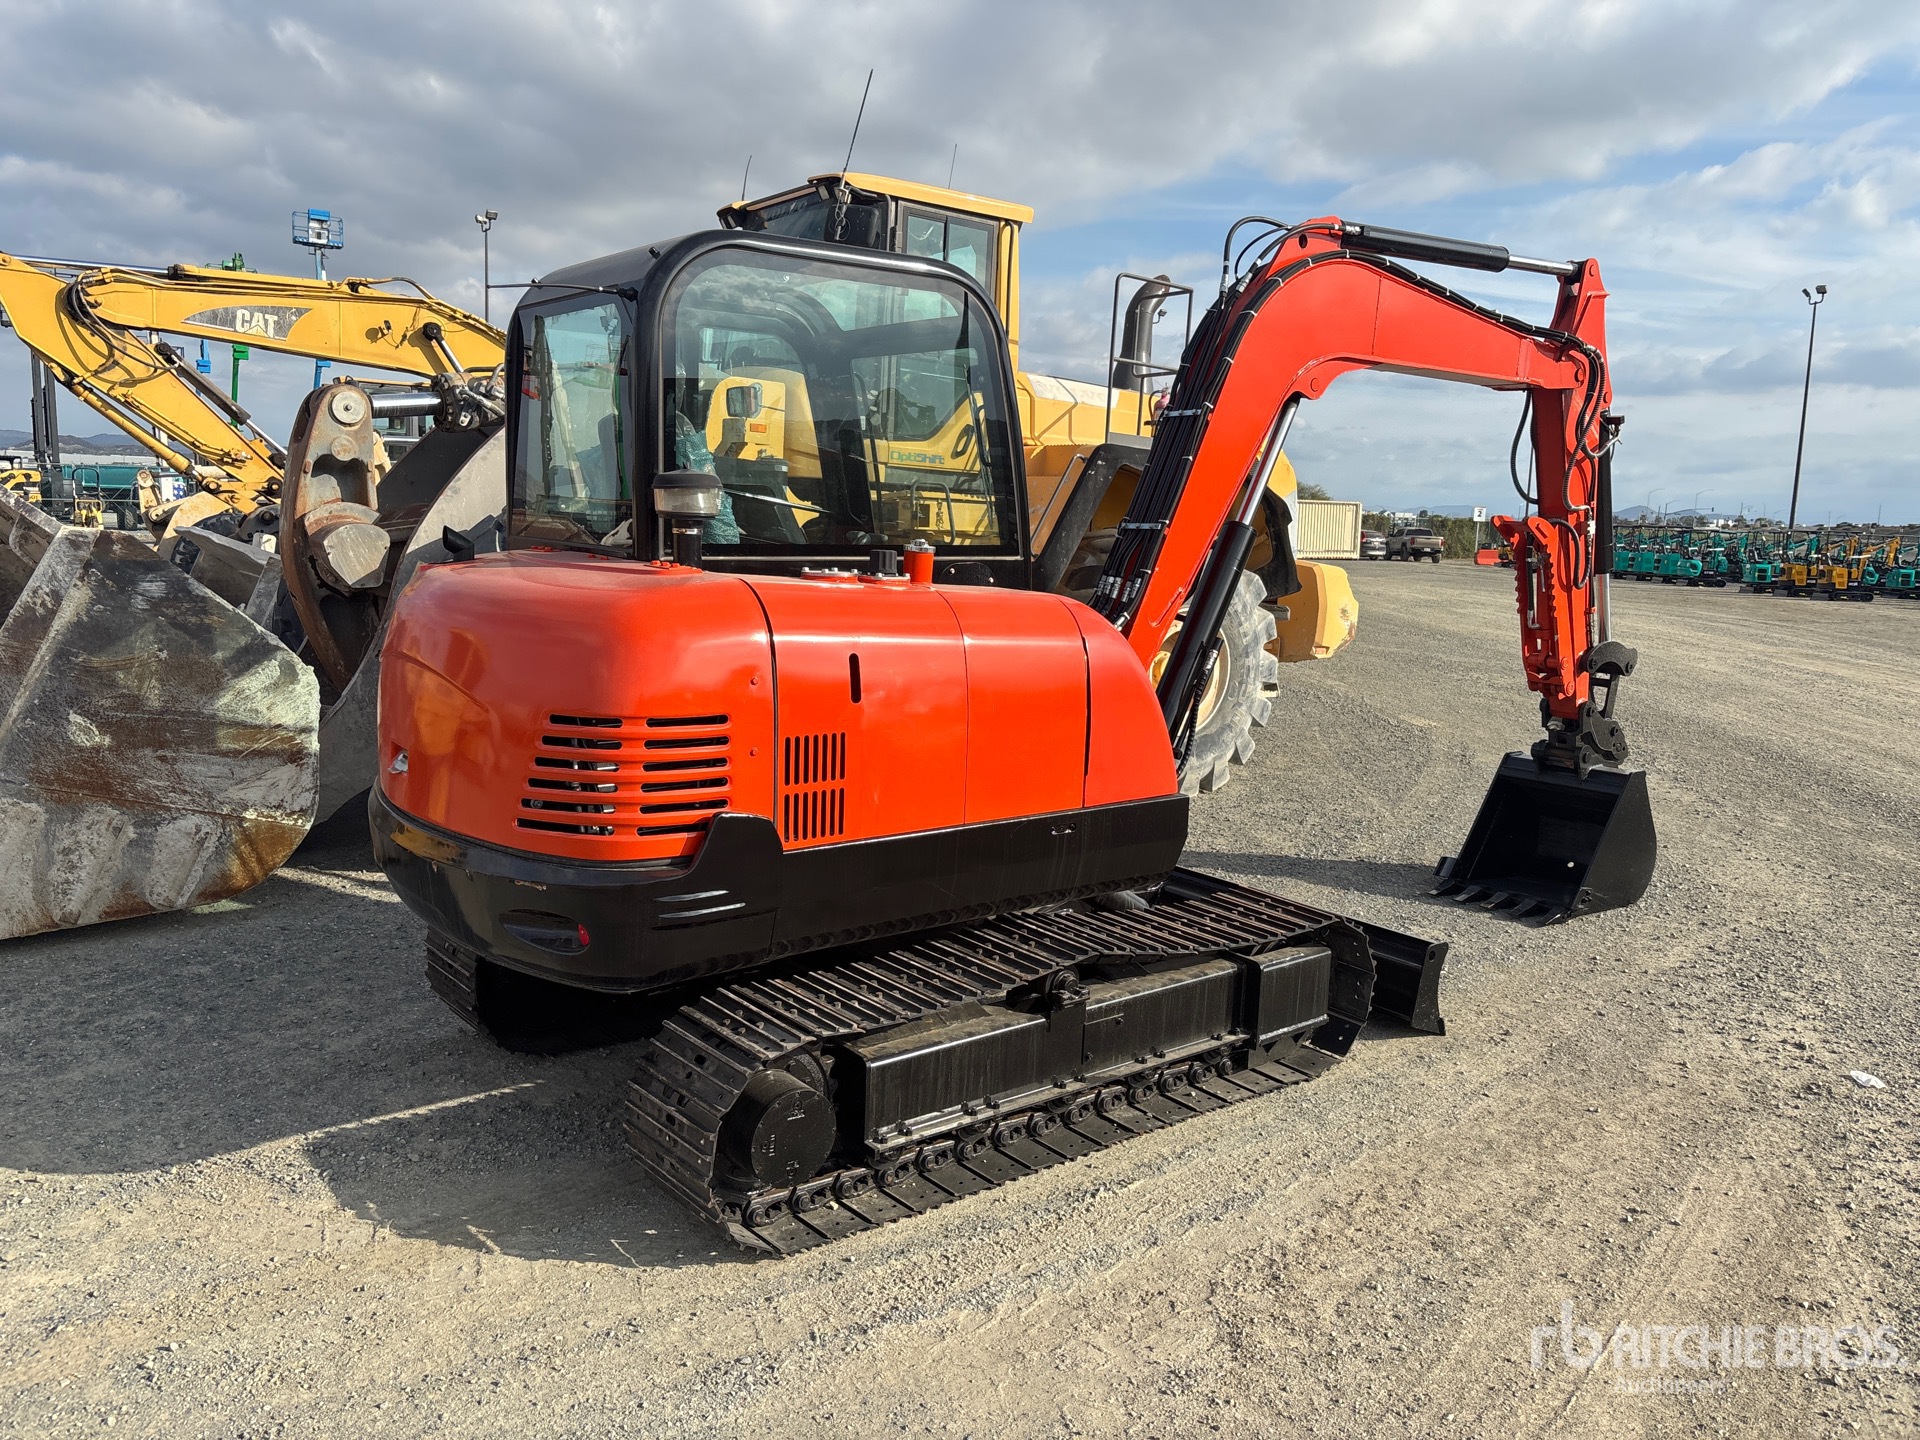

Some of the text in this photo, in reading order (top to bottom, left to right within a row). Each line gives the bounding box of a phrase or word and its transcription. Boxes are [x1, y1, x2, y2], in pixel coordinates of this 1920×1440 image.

[235, 308, 278, 339] CAT
[890, 450, 945, 465] OptiShift
[1476, 510, 1483, 518] 2
